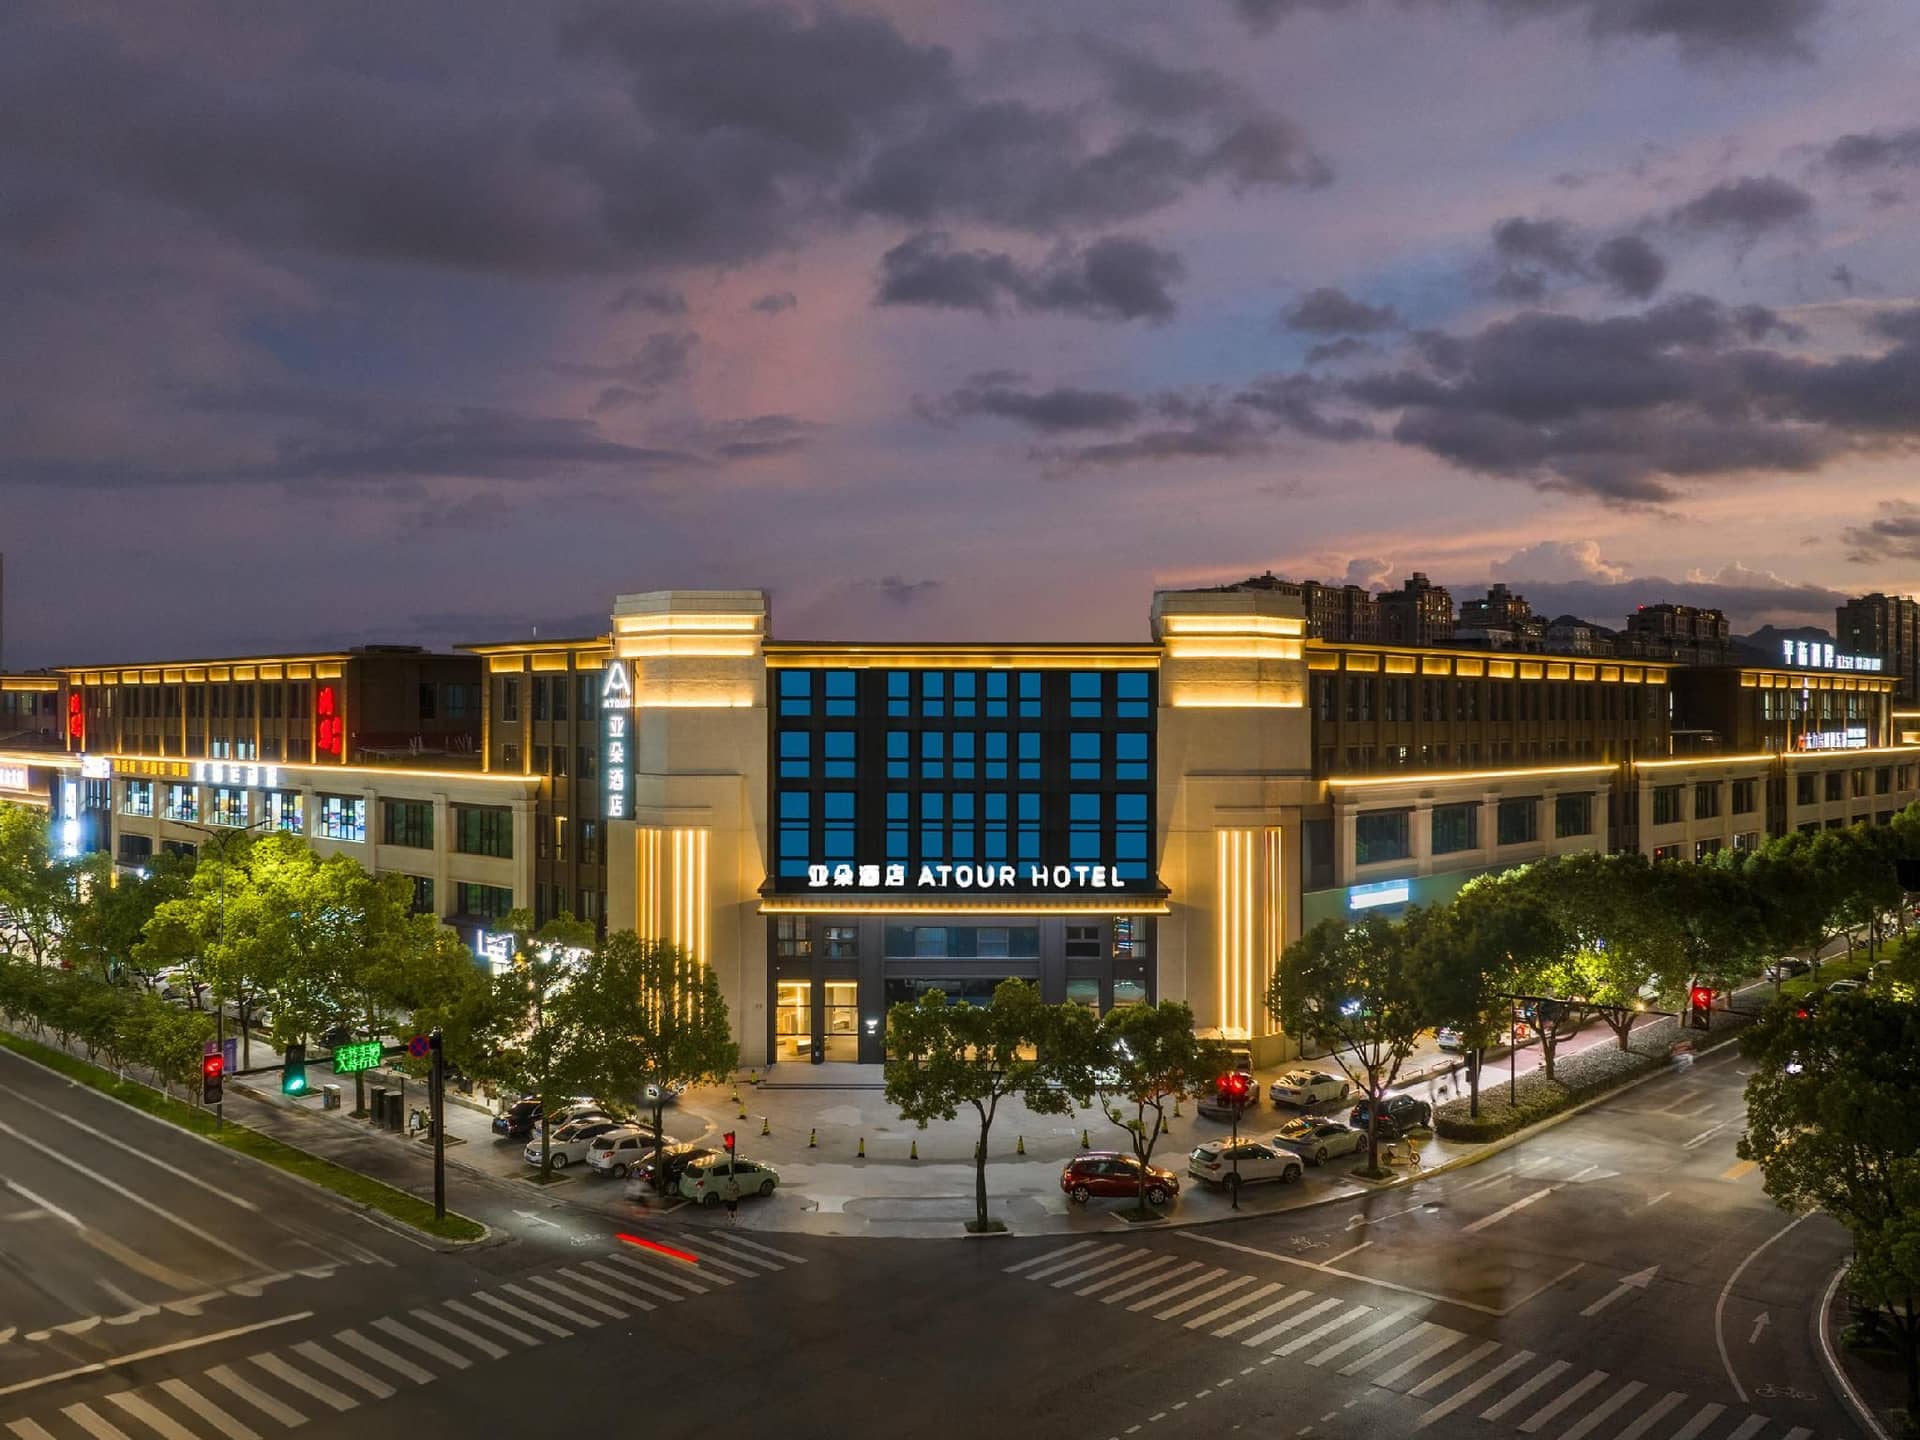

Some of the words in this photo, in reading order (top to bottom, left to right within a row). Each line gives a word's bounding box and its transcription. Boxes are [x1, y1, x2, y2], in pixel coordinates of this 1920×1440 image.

[608, 716, 625, 817] 亚朵酒店
[808, 864, 905, 887] 亚朵酒店
[917, 865, 1016, 888] ATOUR
[1031, 865, 1125, 888] HOTEL
